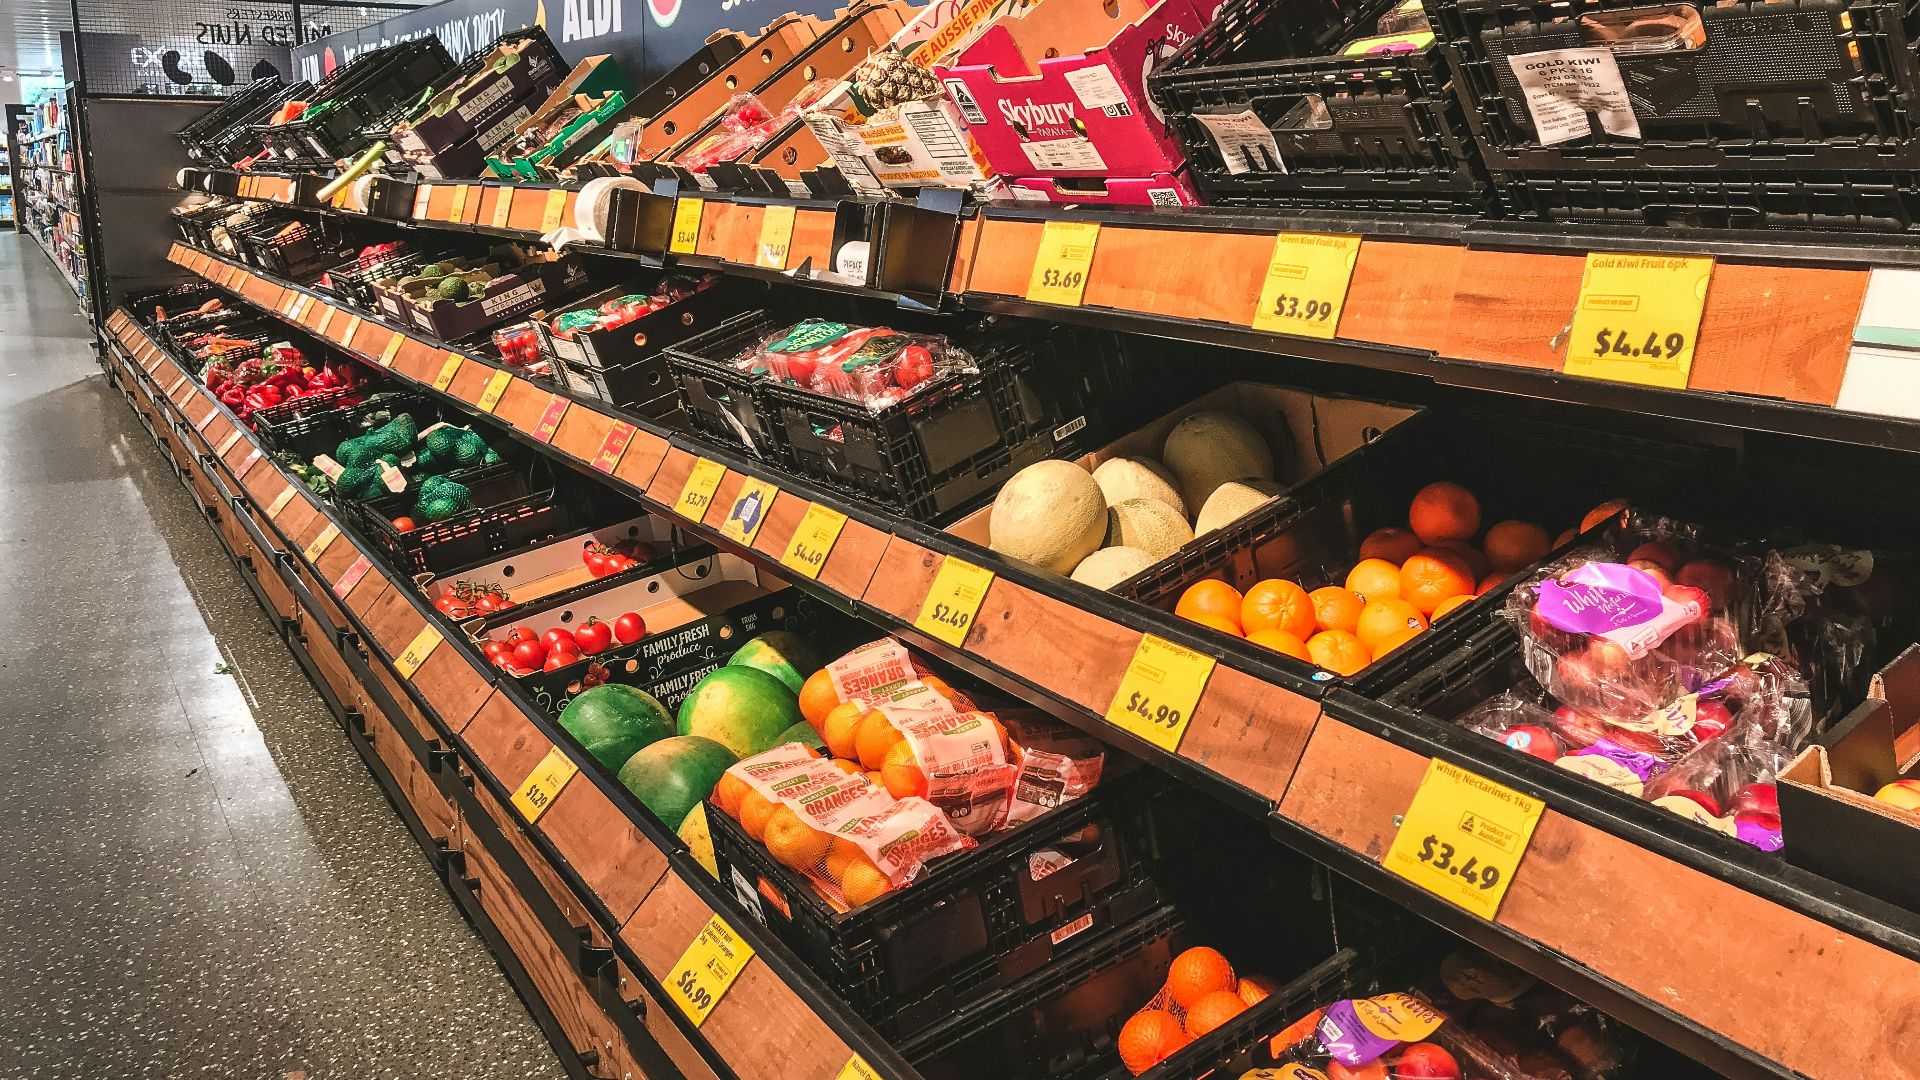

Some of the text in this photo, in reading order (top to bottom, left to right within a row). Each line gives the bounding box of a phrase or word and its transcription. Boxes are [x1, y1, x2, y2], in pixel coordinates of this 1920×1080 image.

[473, 9, 505, 53] DIRTY
[563, 0, 622, 42] ALDI
[930, 13, 974, 58] AUSSIE
[1525, 58, 1601, 70] GOLD KIWI
[997, 97, 1075, 131] Skybury
[1037, 127, 1068, 137] PAPAYA
[910, 170, 941, 179] AUSTRALIA
[678, 231, 695, 243] $3.49
[1280, 235, 1299, 244] Green
[1300, 236, 1316, 245] Kiwi
[1316, 237, 1335, 247] Fruit
[1592, 258, 1689, 271] Gold Kiwi Fruit 6pk
[1043, 267, 1082, 289] $3.69
[491, 289, 519, 304] KING
[1274, 294, 1332, 321] $3.99
[1594, 327, 1684, 359] $4.49
[686, 491, 708, 507] $3.79
[794, 542, 823, 566] $4.49
[1562, 585, 1607, 615] White
[741, 613, 758, 625] TRUSS
[931, 601, 969, 629] $2.49
[643, 623, 710, 658] FAMILY FRESH
[1162, 640, 1187, 657] Oranges
[657, 643, 702, 669] produce
[654, 673, 690, 699] FAMILY
[843, 666, 906, 695] ORANGES
[1127, 691, 1181, 729] $4.99
[967, 754, 993, 770] PERFECT
[526, 783, 548, 808] $1.29
[773, 777, 801, 791] MARKET
[1436, 763, 1533, 813] White Nectarines 1kg
[800, 790, 828, 804] MARKET
[805, 782, 868, 816] ORANGES
[1478, 830, 1507, 847] Australia
[1480, 821, 1513, 841] Product of
[886, 821, 948, 868] ORANGES
[1417, 834, 1500, 890] $3.49
[700, 933, 709, 946] 3kg
[710, 920, 734, 943] MARKET BUY
[718, 941, 735, 960] Oranges
[677, 969, 712, 1010] $6.99
